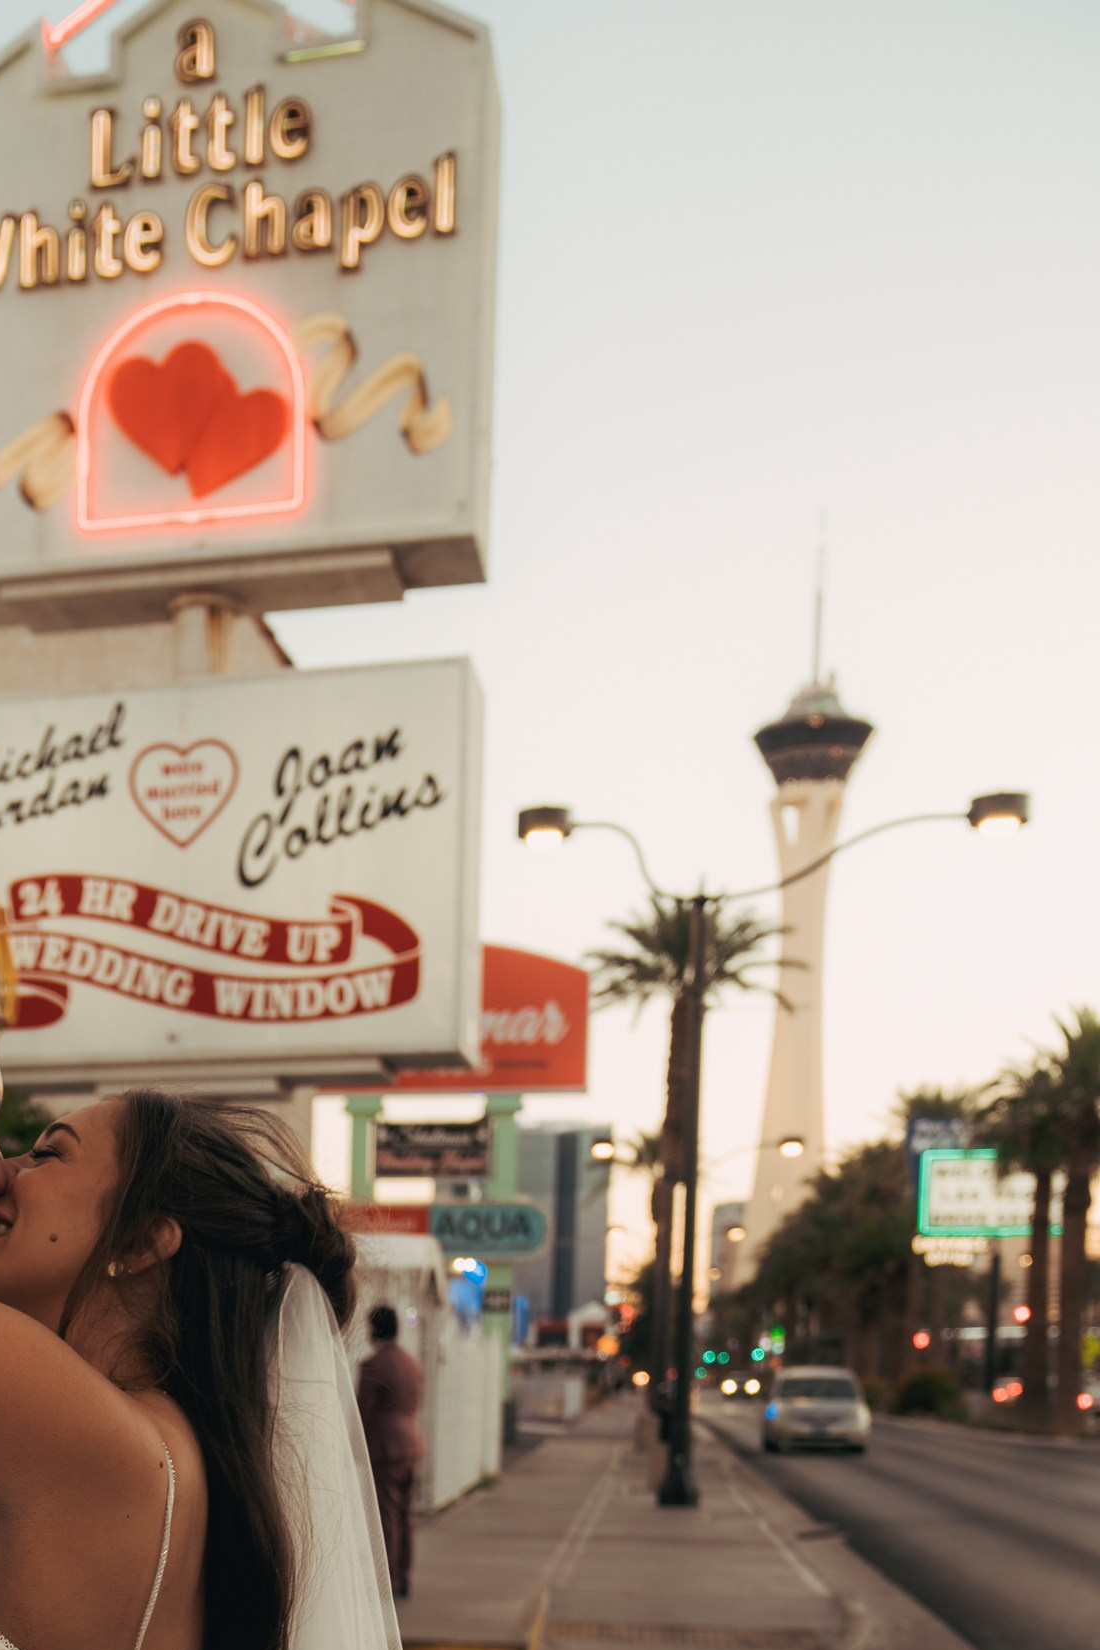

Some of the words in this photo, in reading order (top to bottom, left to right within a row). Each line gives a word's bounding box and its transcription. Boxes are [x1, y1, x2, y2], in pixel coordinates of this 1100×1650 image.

[176, 18, 216, 84] a
[88, 83, 312, 191] Little
[184, 149, 458, 274] Chapel
[274, 724, 407, 827] Joan
[235, 772, 448, 889] Collins
[17, 877, 63, 917] 24
[78, 878, 138, 922] HR
[149, 894, 272, 959] DRIVE
[287, 923, 343, 963] UP
[9, 933, 195, 1007] WEDDING
[213, 967, 396, 1020] WINDOW
[435, 1209, 534, 1241] AQUA
